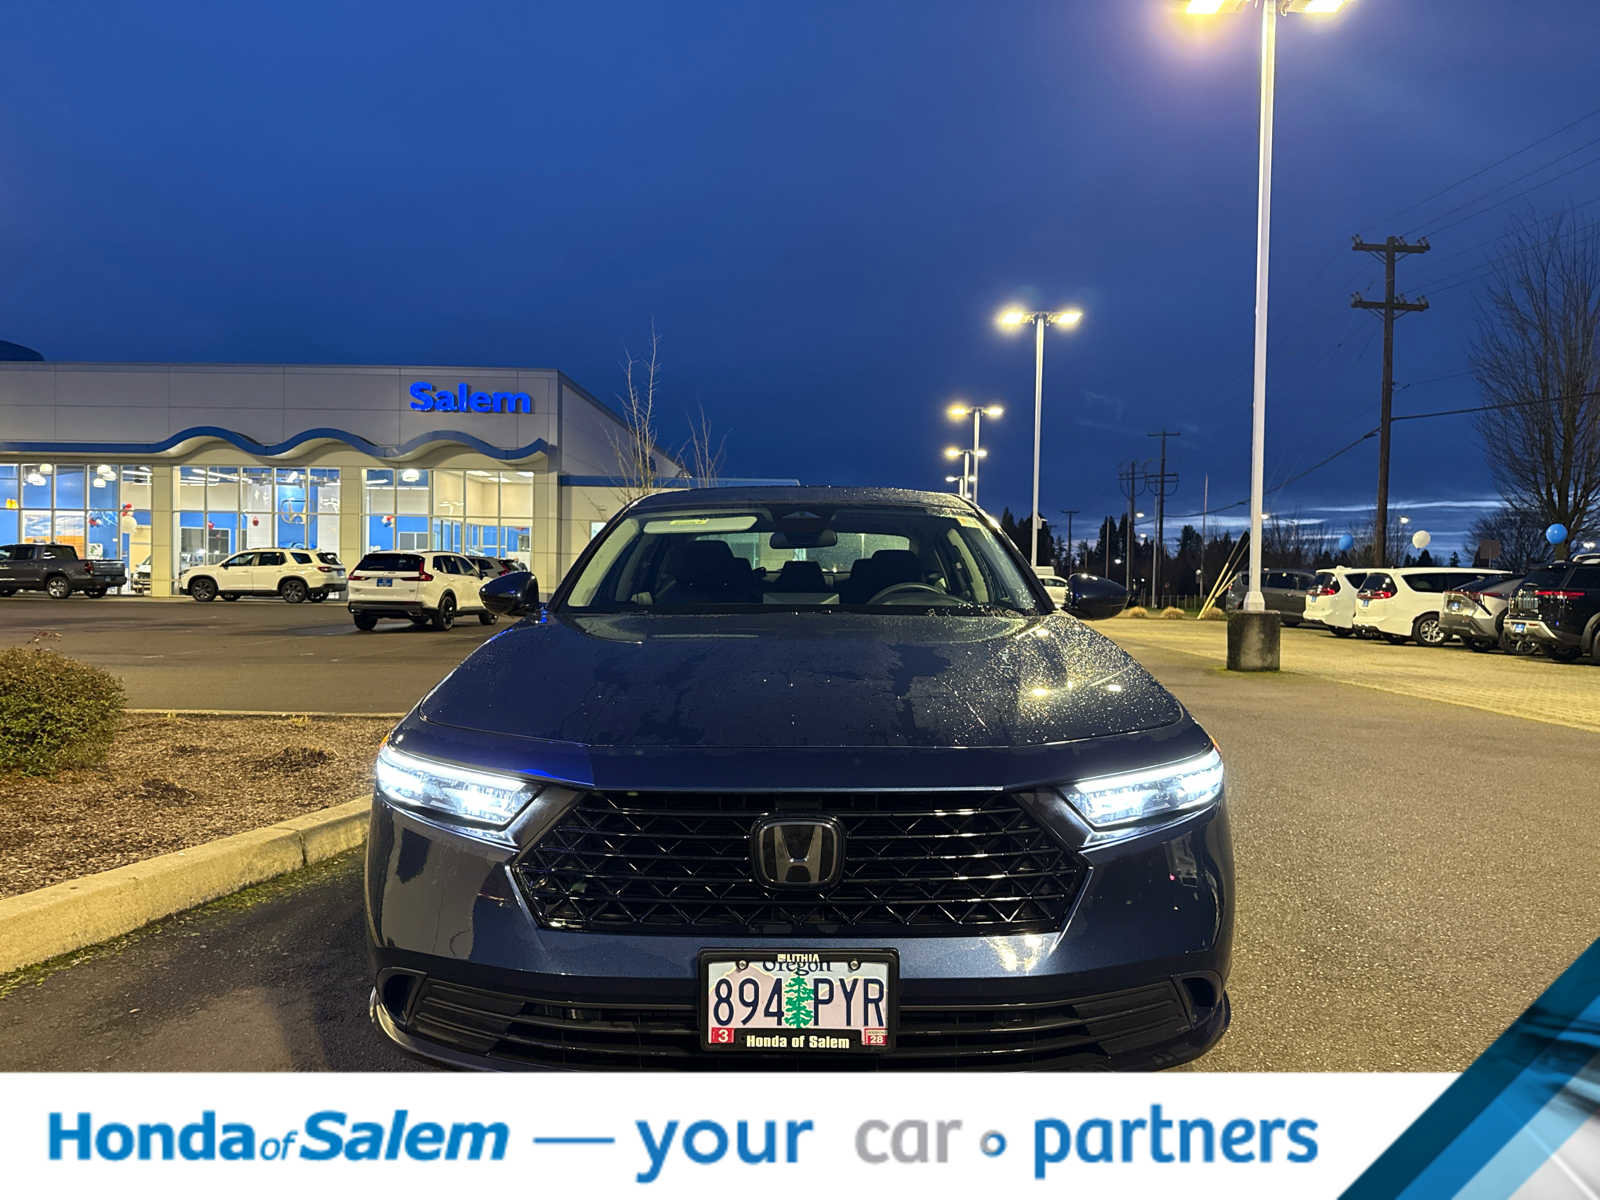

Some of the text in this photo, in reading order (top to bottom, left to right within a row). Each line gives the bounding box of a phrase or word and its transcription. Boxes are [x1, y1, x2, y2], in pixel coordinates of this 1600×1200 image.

[410, 381, 532, 414] Salem
[786, 953, 820, 963] LITHIA
[713, 977, 885, 1027] 894 PYR
[717, 1029, 729, 1042] 3
[746, 1035, 850, 1049] Honda of Salem
